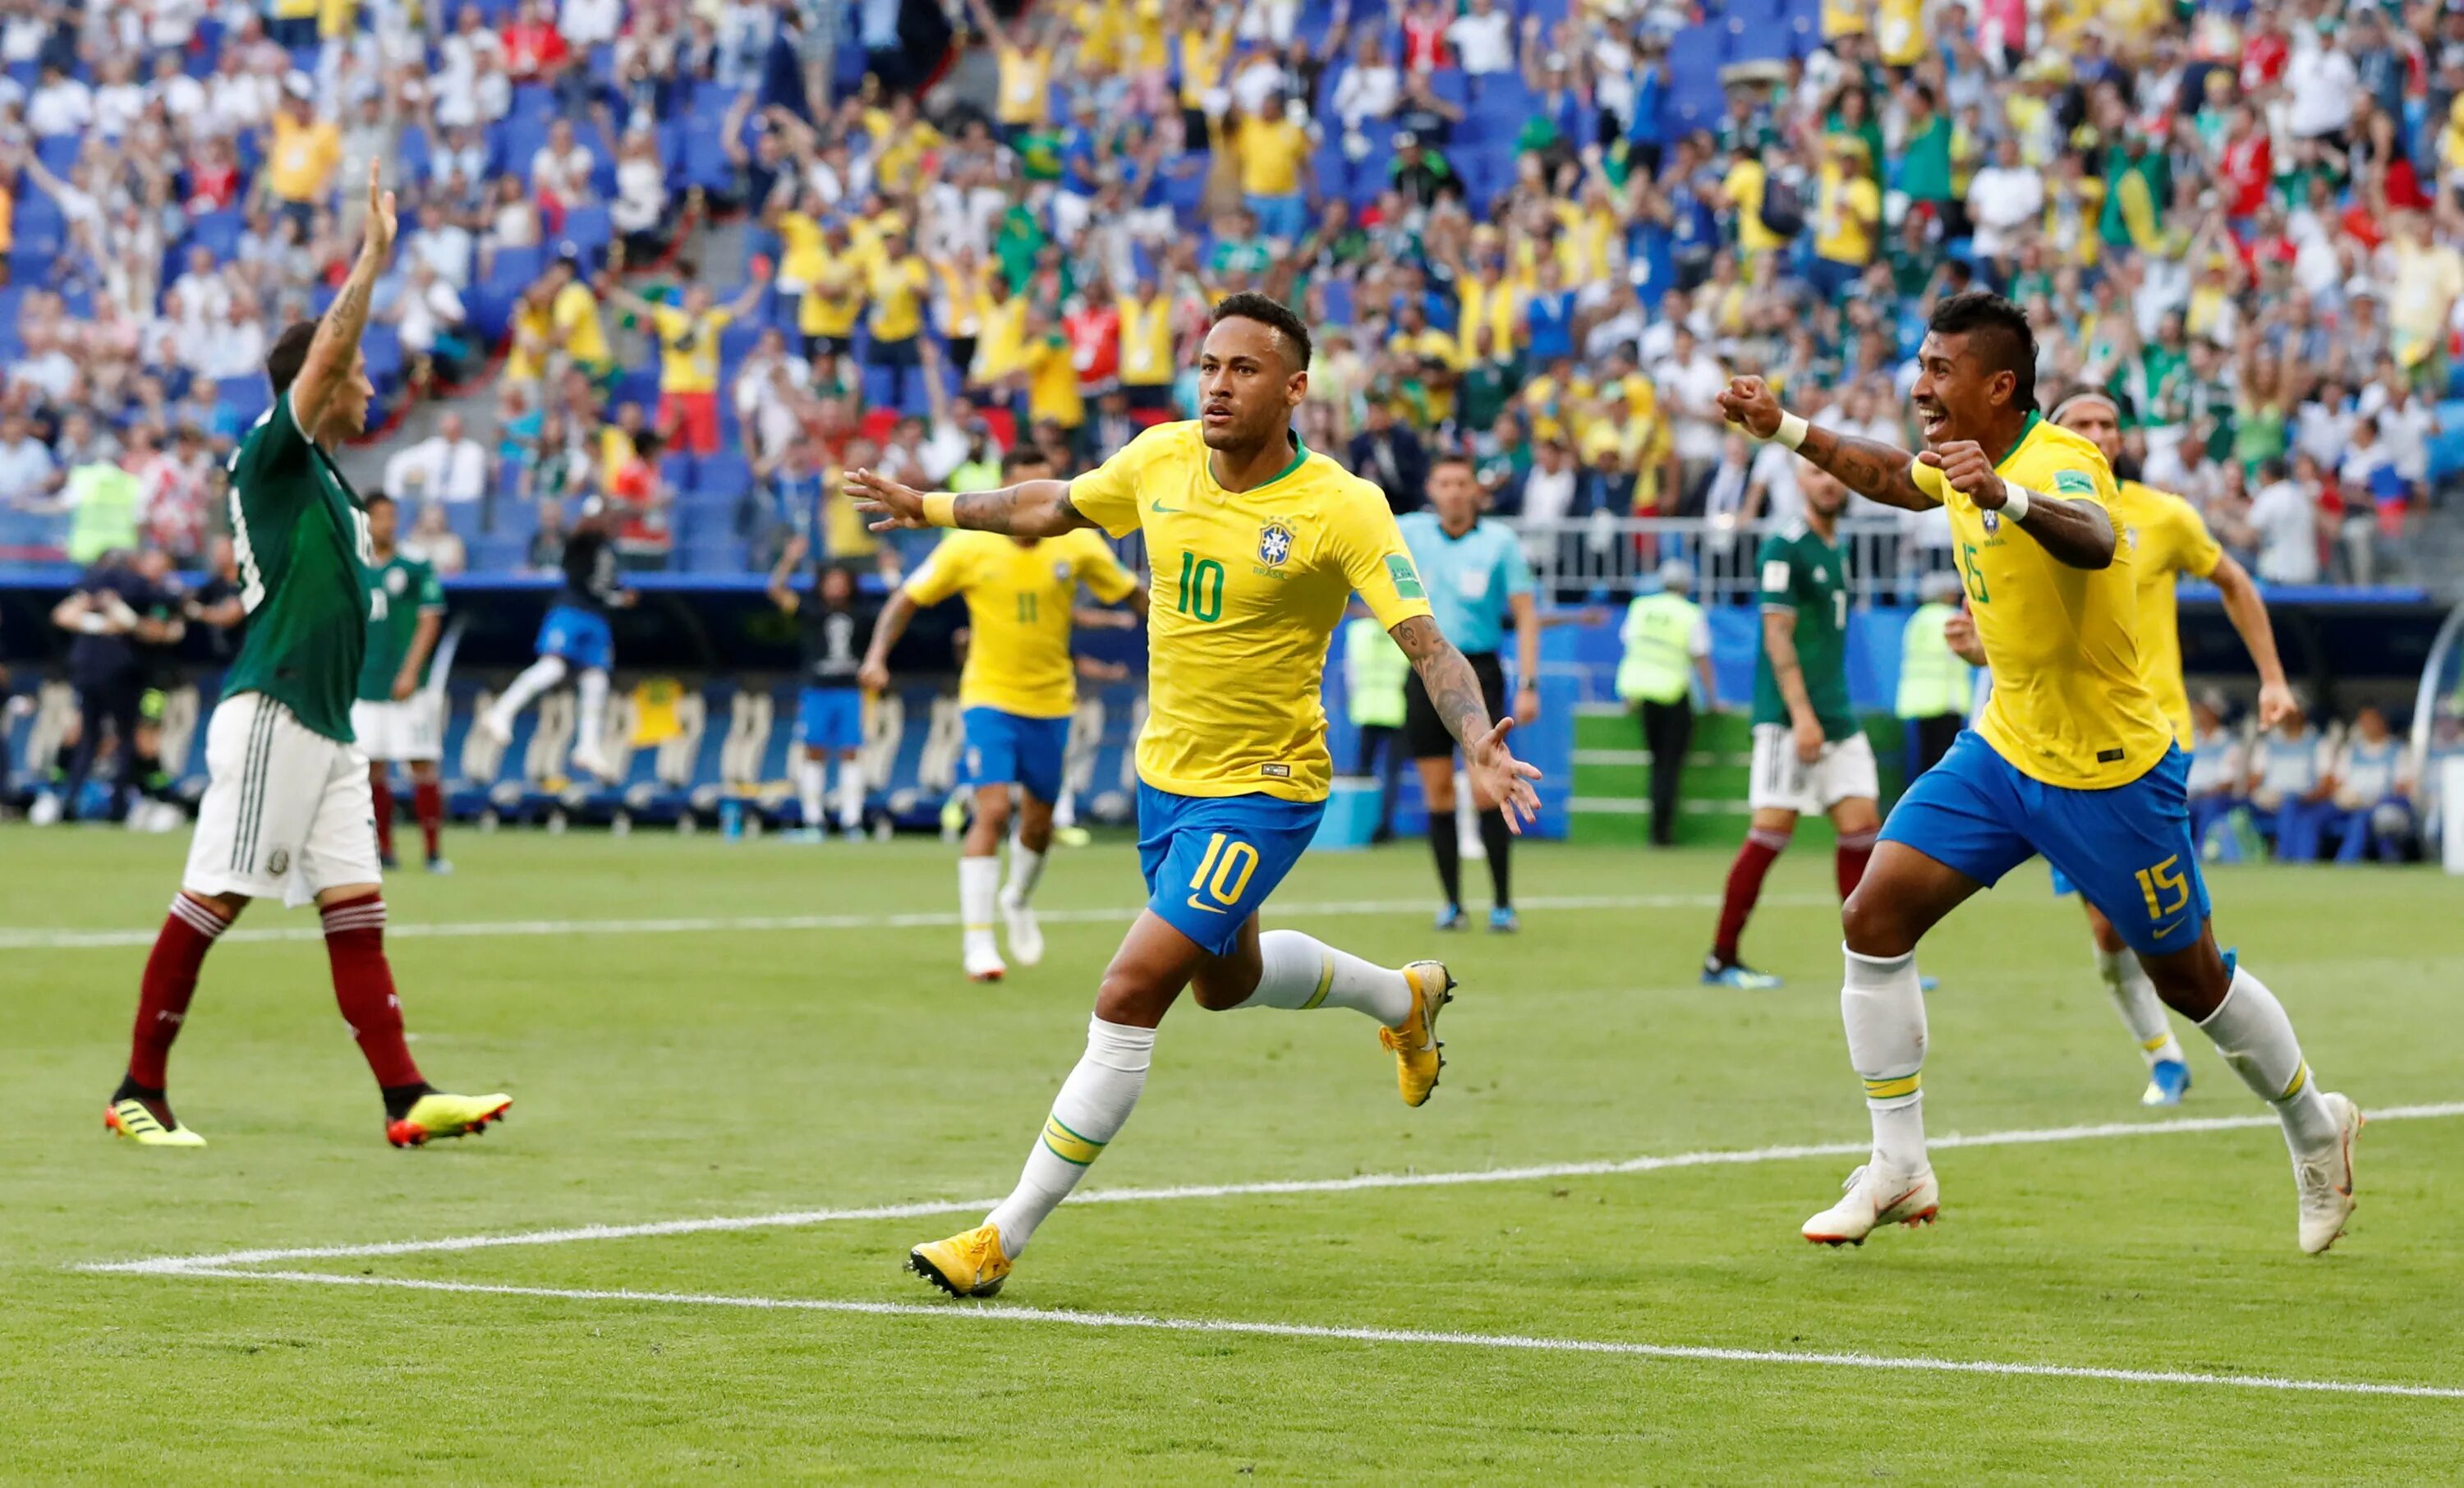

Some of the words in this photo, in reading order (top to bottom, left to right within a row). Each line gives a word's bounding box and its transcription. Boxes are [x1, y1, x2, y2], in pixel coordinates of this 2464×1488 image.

[1178, 551, 1224, 622] 10
[1253, 566, 1289, 581] BRASIL
[1962, 542, 1989, 604] 15
[1189, 833, 1259, 905] 10
[2135, 854, 2190, 920] 15
